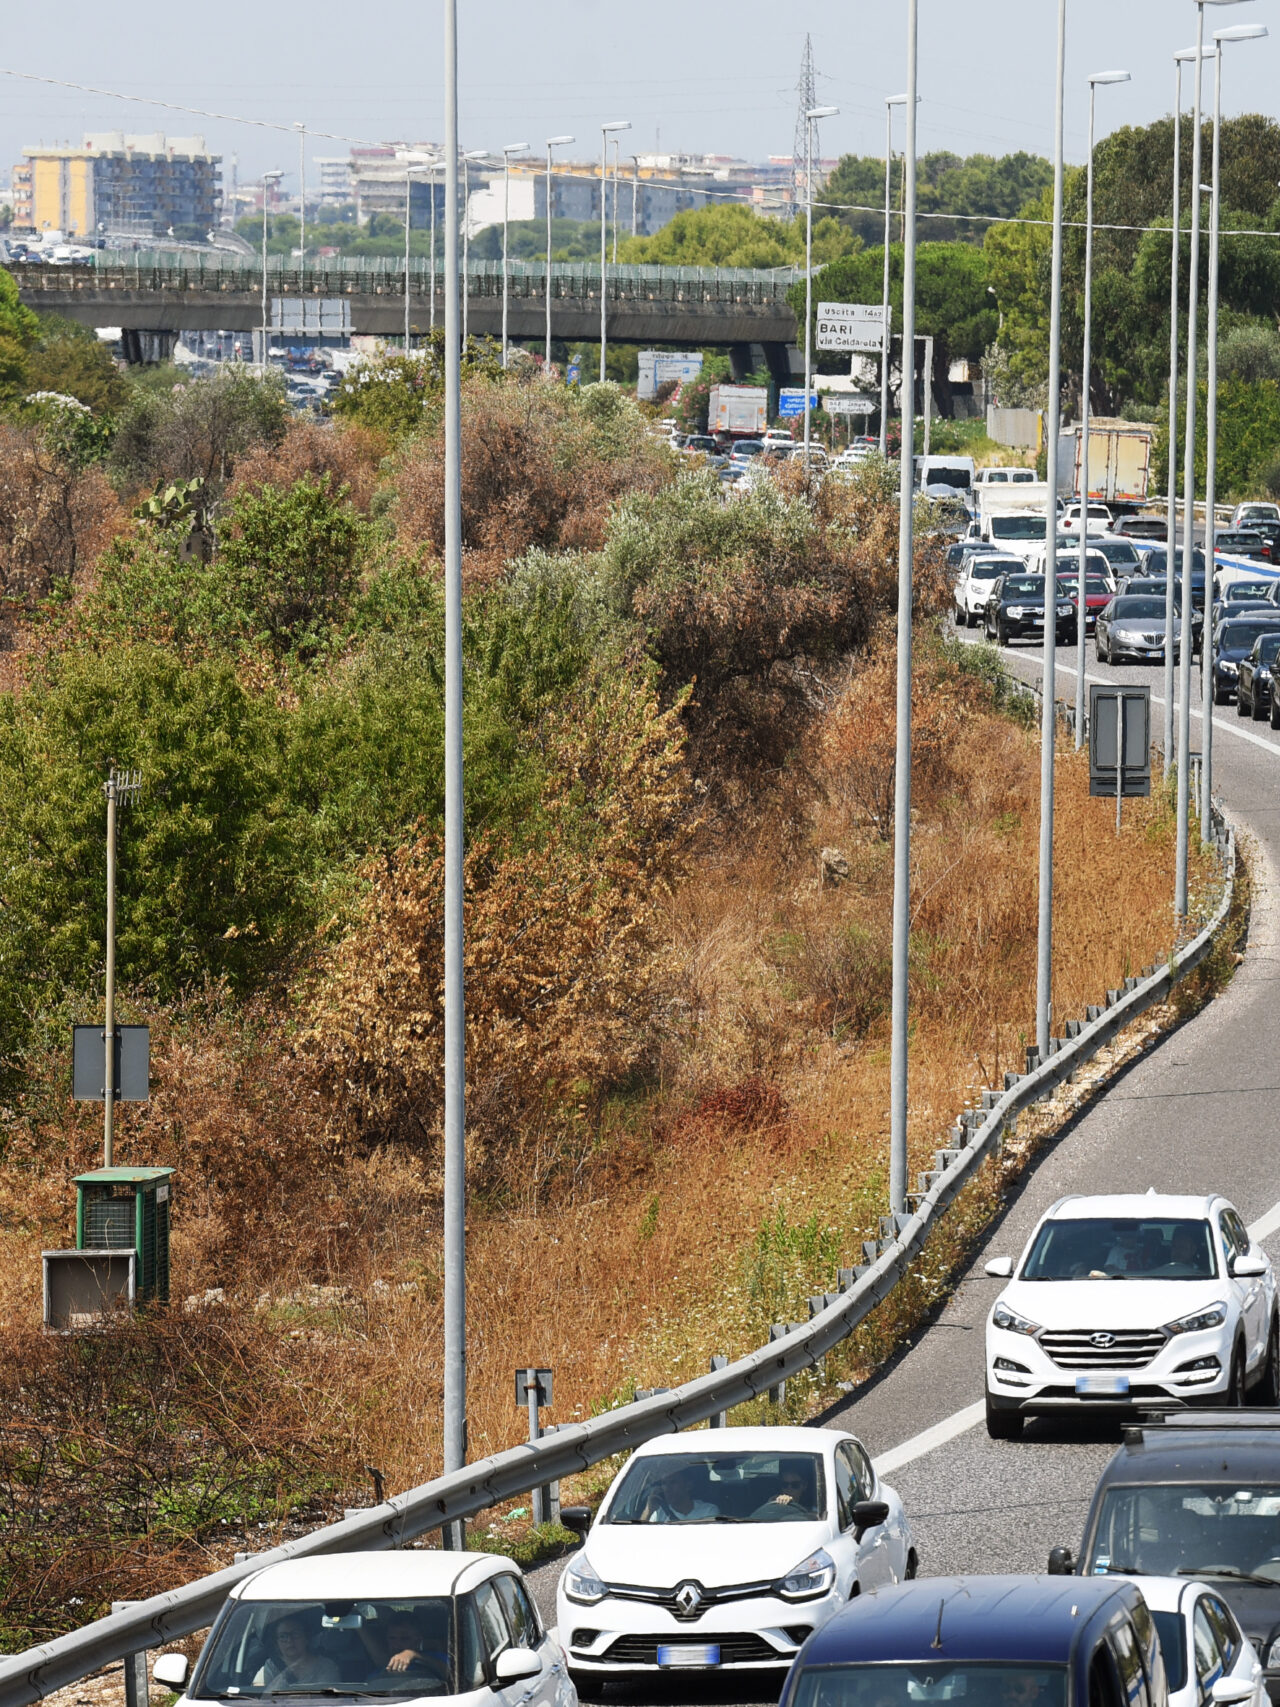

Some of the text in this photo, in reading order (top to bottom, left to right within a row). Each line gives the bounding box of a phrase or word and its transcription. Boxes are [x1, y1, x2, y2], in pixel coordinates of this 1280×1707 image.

[820, 323, 852, 335] BARI
[819, 336, 877, 348] via Caldarola
